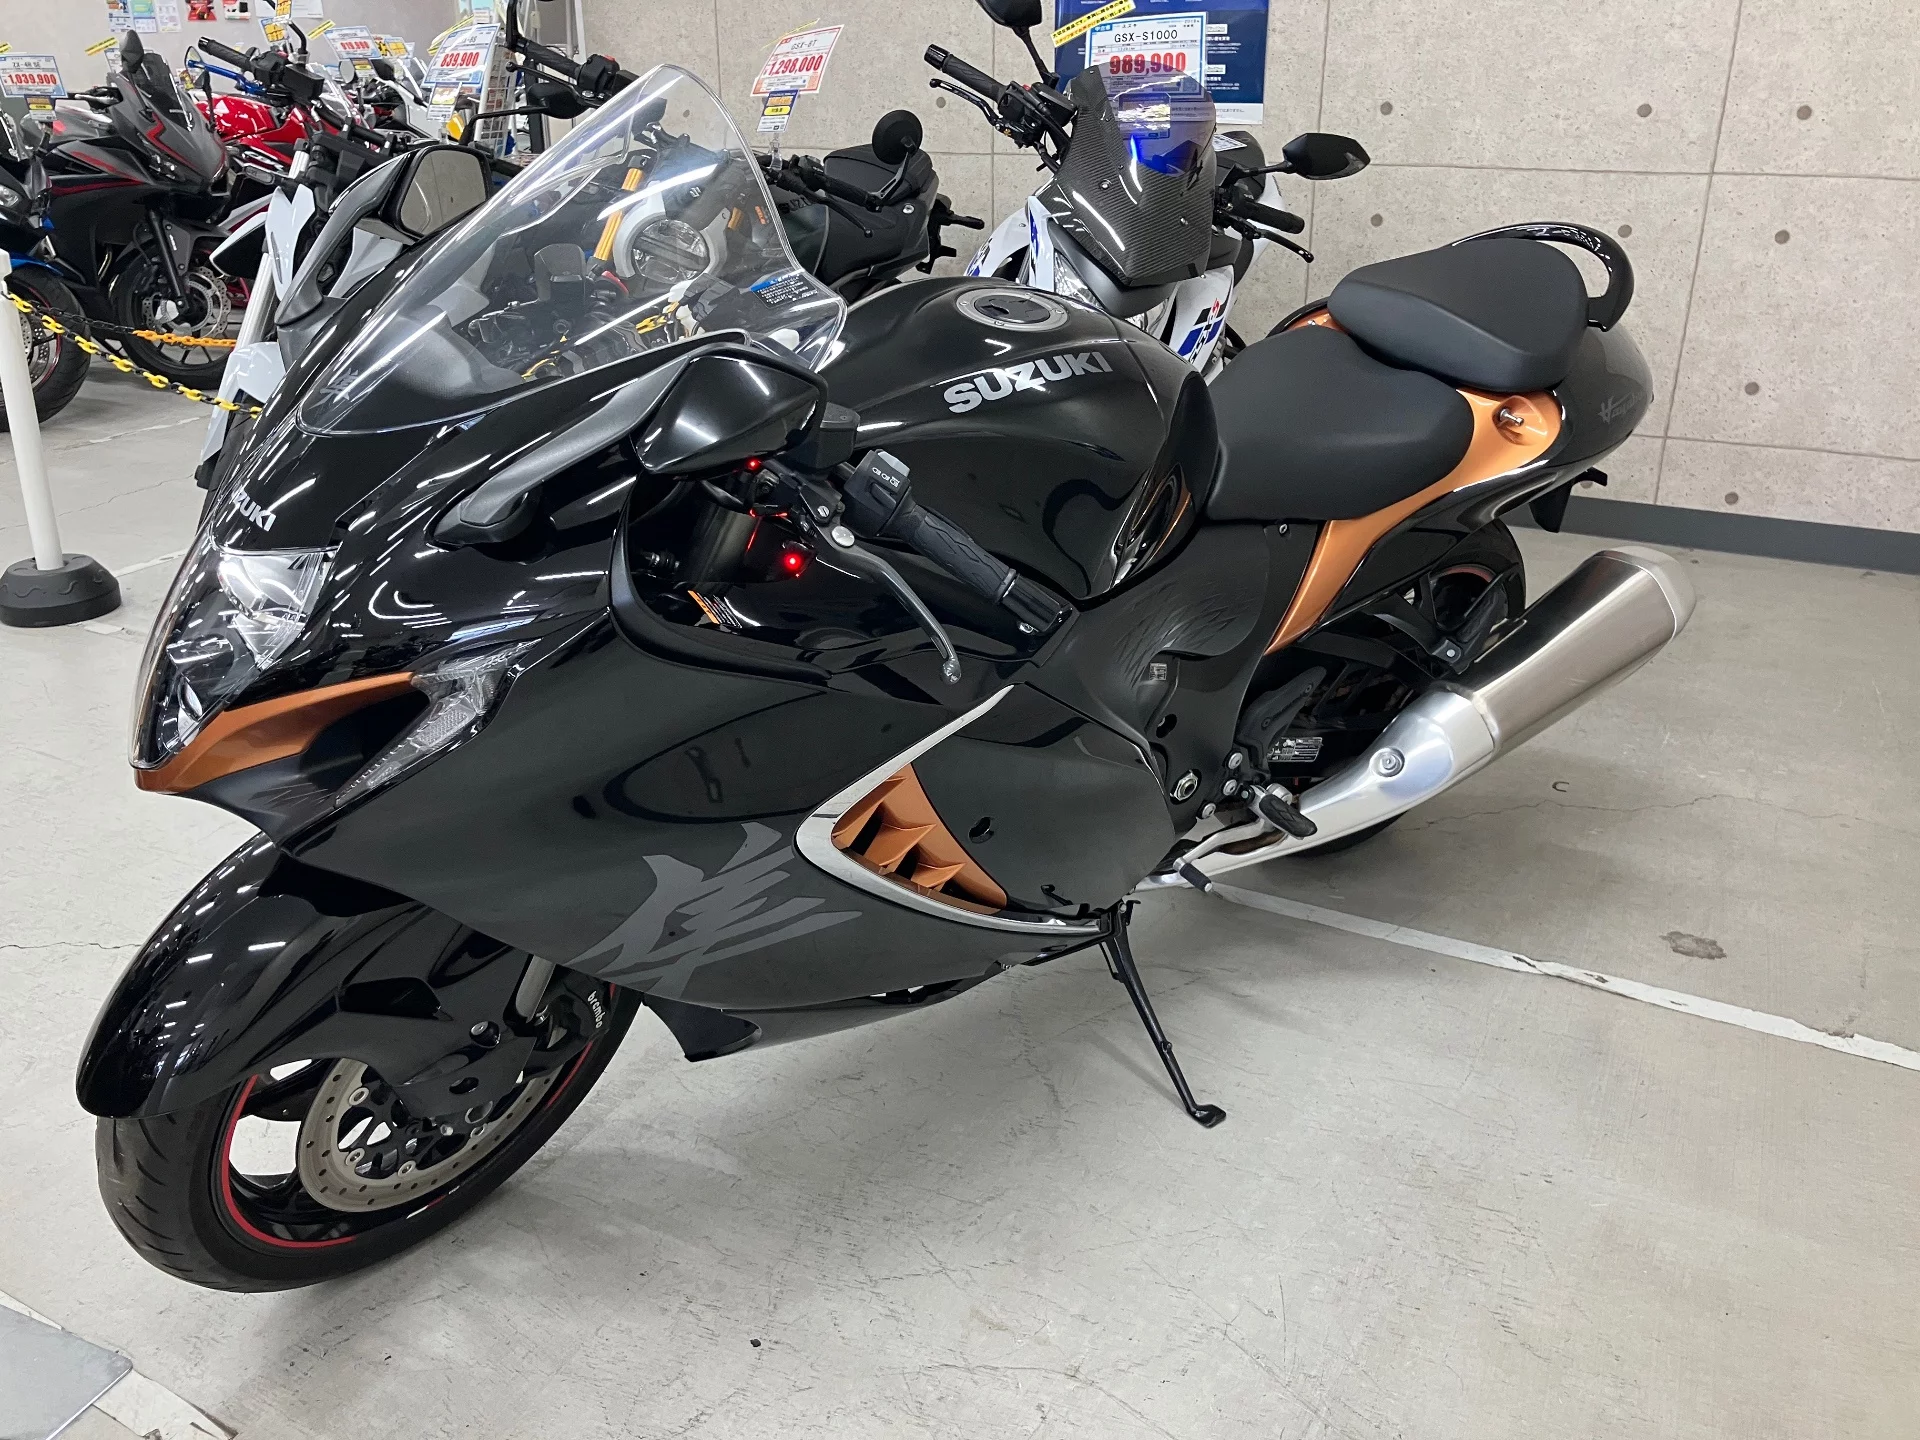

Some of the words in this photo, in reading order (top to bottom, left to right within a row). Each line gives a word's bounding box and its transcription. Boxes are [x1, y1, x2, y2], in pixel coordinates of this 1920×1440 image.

[1114, 29, 1178, 43] GSX-S1000
[440, 51, 480, 67] 839,900
[768, 54, 824, 77] 1,298,000
[1109, 52, 1187, 76] 989,900
[8, 73, 57, 86] 1,039,900
[943, 351, 1114, 414] SUZUKI
[587, 990, 606, 1029] brembo
